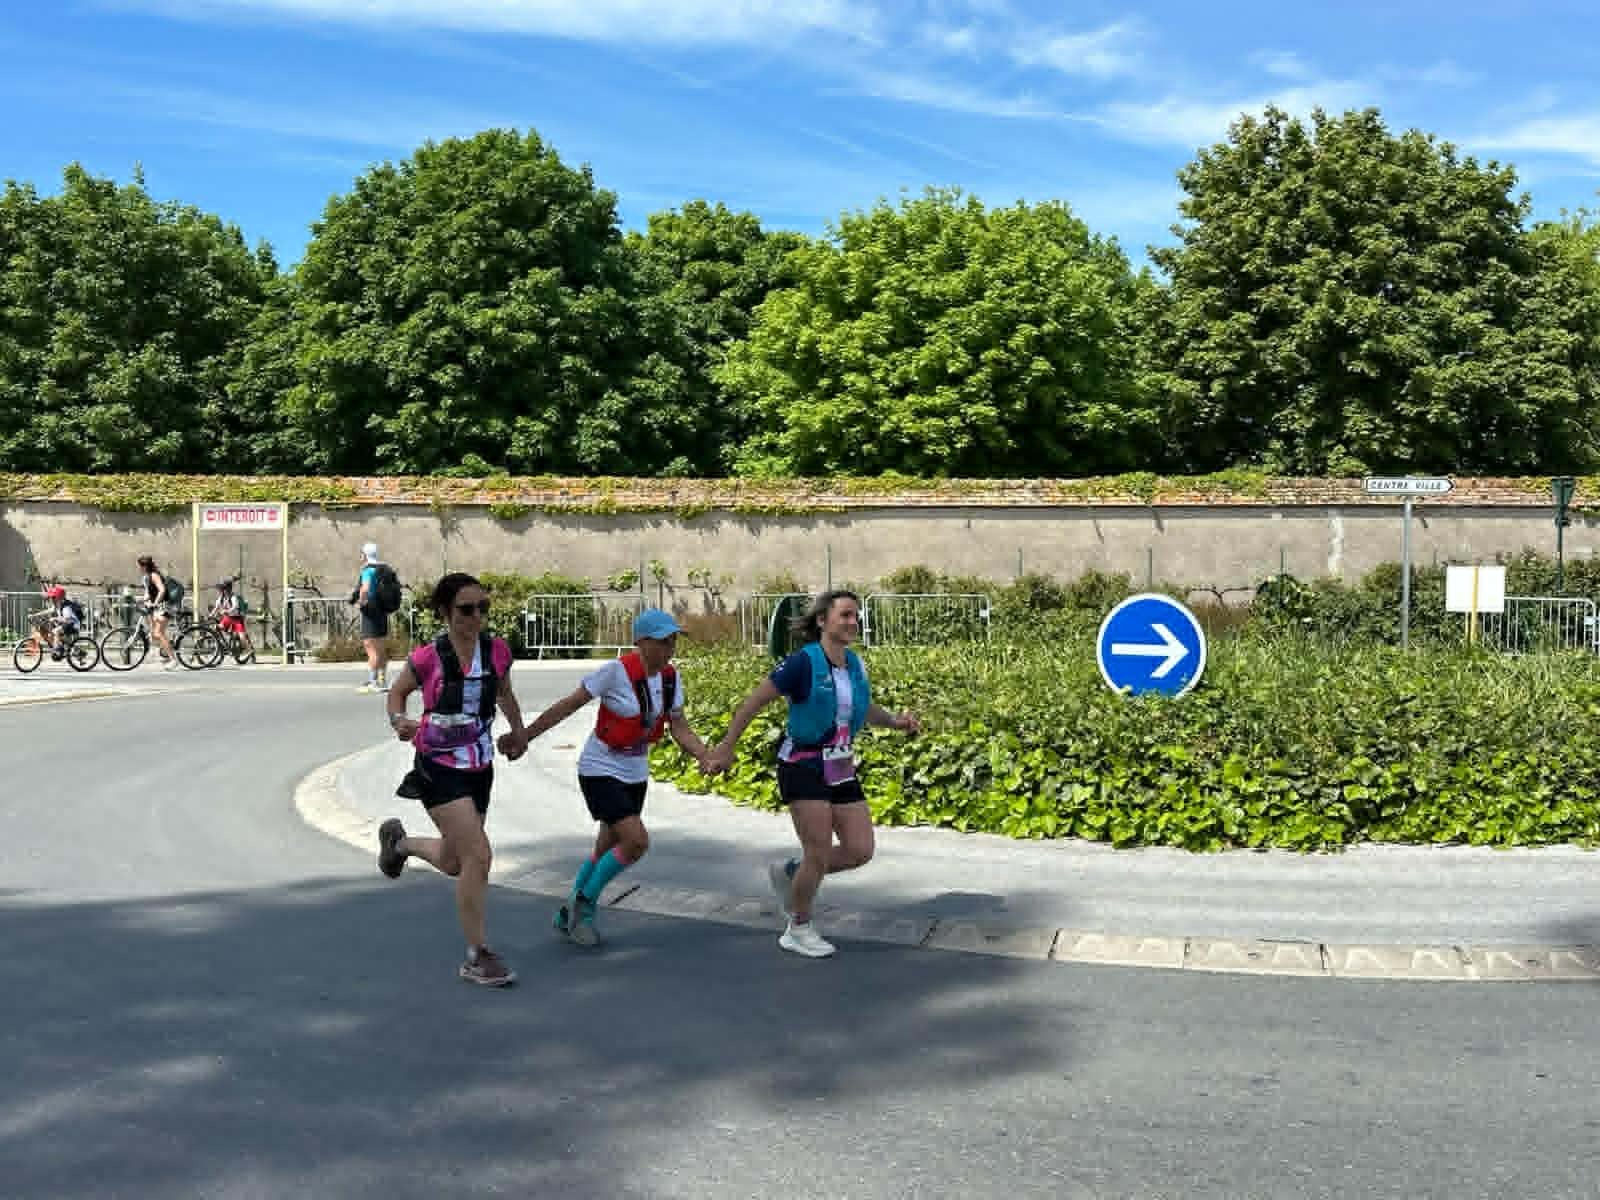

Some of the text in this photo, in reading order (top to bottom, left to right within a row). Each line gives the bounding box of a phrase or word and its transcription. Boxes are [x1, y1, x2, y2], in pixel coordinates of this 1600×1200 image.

[1370, 480, 1442, 490] CENTRE VILLE
[217, 508, 266, 522] INTERDIT
